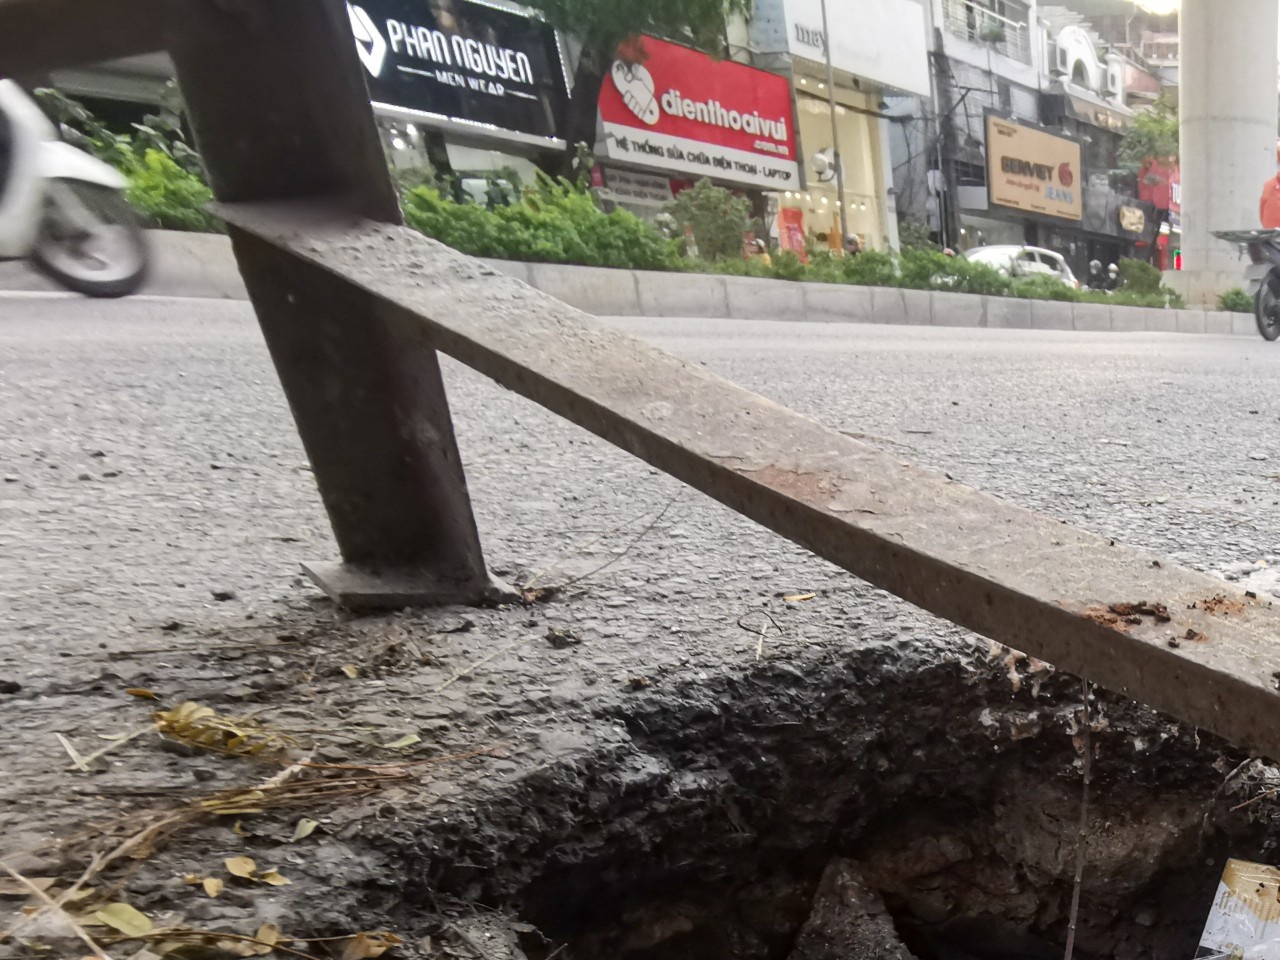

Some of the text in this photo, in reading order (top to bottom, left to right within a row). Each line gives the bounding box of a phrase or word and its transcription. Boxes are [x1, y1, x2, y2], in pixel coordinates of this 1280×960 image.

[386, 18, 534, 85] PHAN NGUYEN
[435, 69, 506, 97] MEN WEAR
[661, 88, 788, 141] dienthoaivui
[762, 166, 792, 181] LAPTOP
